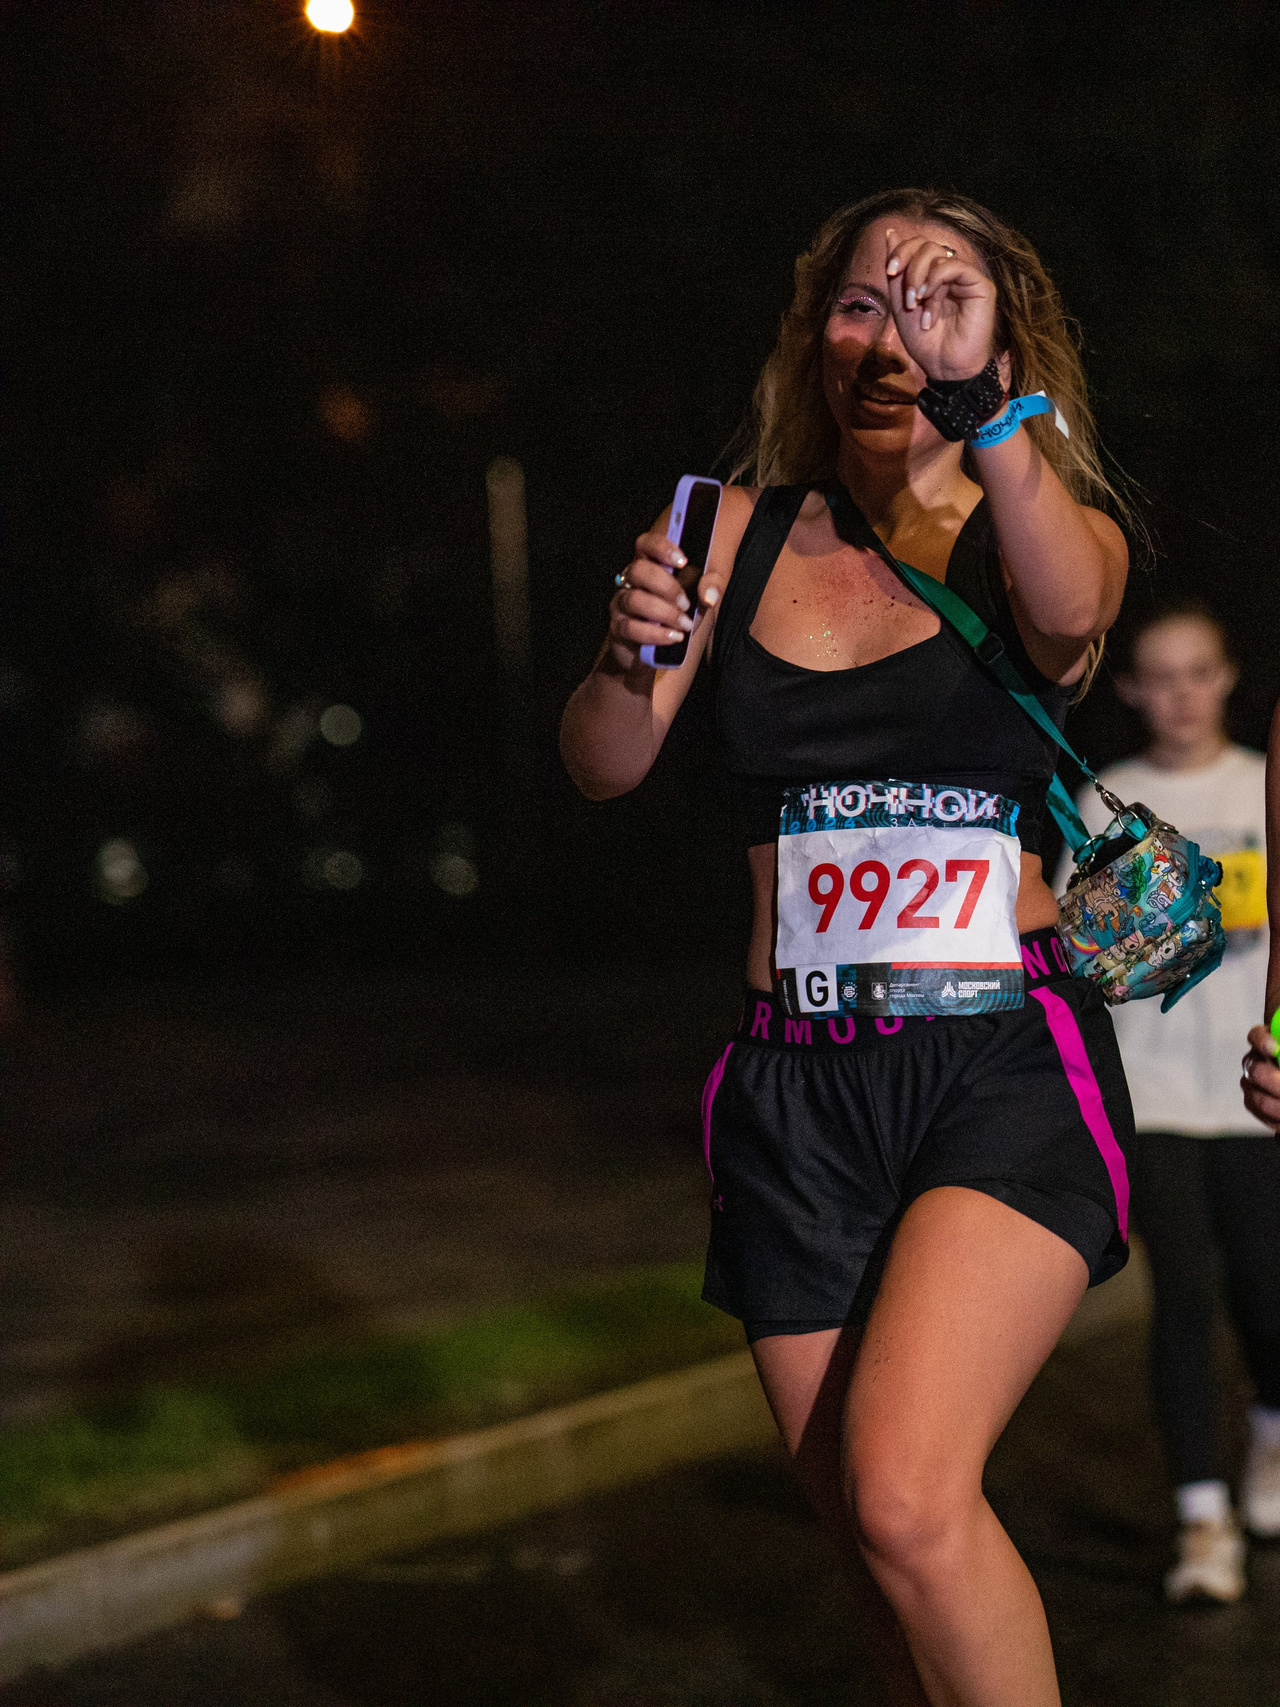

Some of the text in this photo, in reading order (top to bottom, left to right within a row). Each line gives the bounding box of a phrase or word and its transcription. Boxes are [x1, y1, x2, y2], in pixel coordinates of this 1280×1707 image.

[799, 784, 999, 822] НОЧНОЙ
[808, 858, 991, 934] 9927
[805, 970, 829, 1008] G
[958, 979, 1001, 990] МОСКОВСКИЙ
[958, 990, 979, 998] СПОРТ
